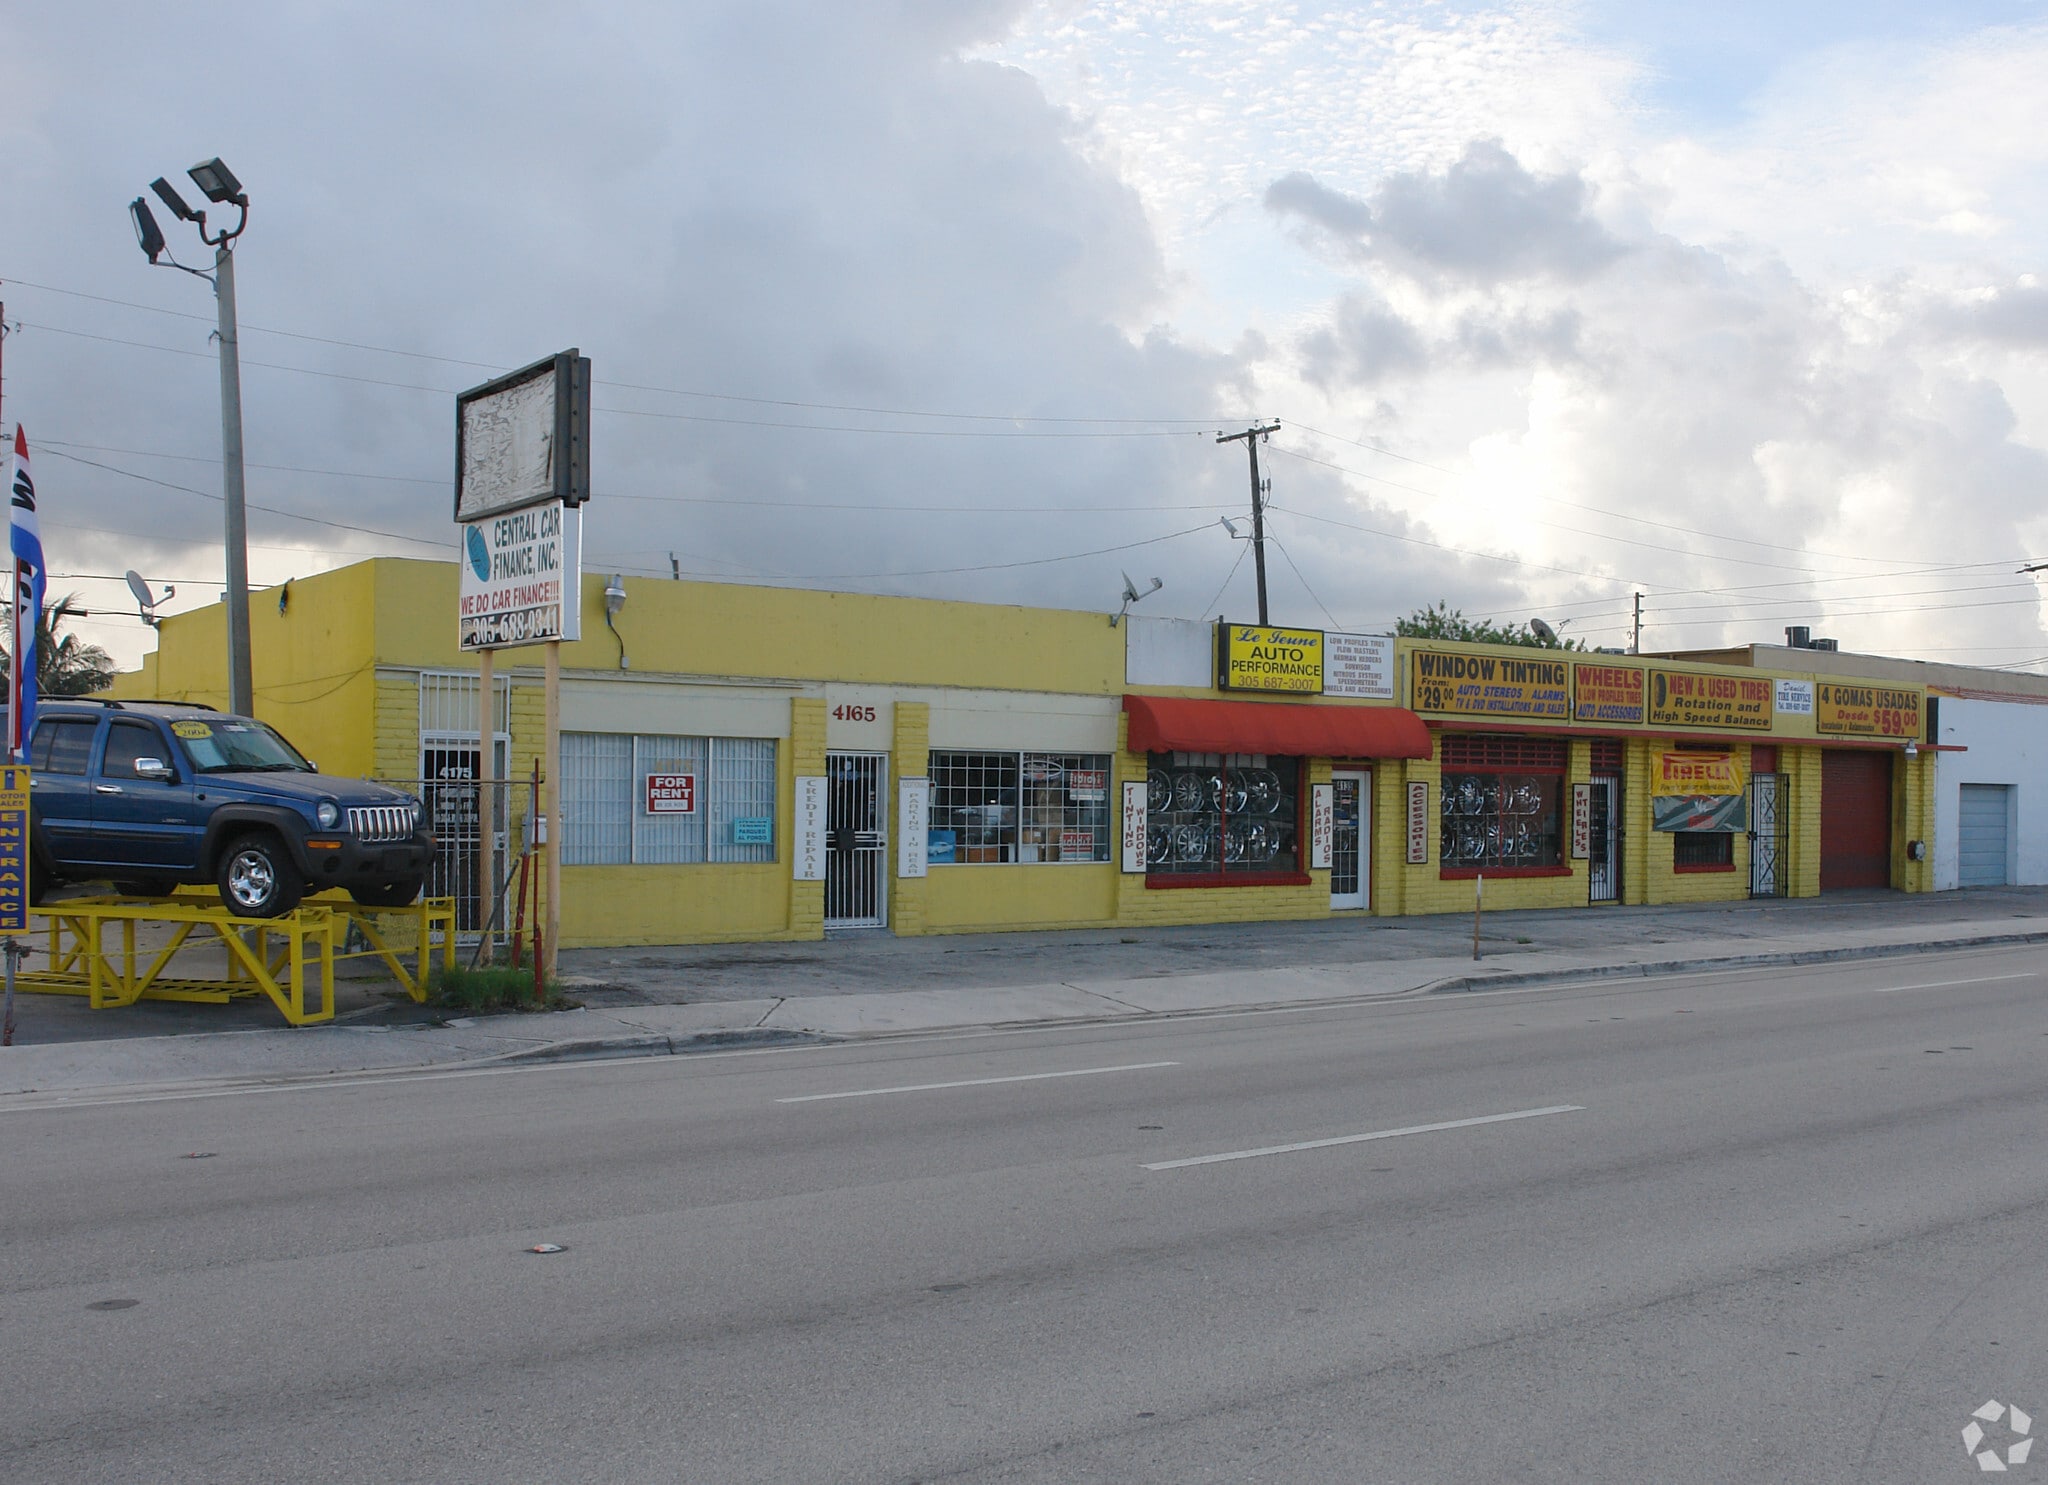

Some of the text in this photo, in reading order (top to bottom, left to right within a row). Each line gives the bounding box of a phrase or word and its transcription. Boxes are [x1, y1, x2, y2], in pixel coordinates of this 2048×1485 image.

[495, 507, 559, 548] CENTRAL CAR
[493, 541, 559, 581] FINANCE, INC.
[460, 580, 560, 616] WE DO CAR FINANCE!!!
[1236, 627, 1261, 643] Le
[1329, 637, 1343, 646] LOW
[1370, 640, 1386, 648] TIRES
[1250, 647, 1303, 661] AUTO
[1231, 659, 1321, 677] PERFORMANCE
[1419, 654, 1565, 686] WINDOW TINTING
[1238, 675, 1315, 690] 305 687-3007
[1337, 678, 1379, 687] SPEEDOMETERS
[1421, 677, 1450, 688] From:
[1577, 666, 1643, 689] WHEELS
[1357, 686, 1392, 695] ACCESSORIES
[1457, 684, 1481, 696] AUTO
[1483, 686, 1523, 699] STEREOS
[1531, 689, 1566, 702] ALARMS
[1583, 688, 1596, 702] LOW
[1597, 690, 1625, 704] PROFILES
[1626, 691, 1642, 705] TIRES
[1669, 675, 1770, 702] NEW & USED TIRES
[1778, 692, 1811, 703] TIRE SERVICE
[1455, 697, 1464, 709] TV
[1487, 699, 1531, 713] INSTALLATIONS
[1546, 704, 1566, 714] SALES
[1674, 697, 1761, 713] Rotation and
[1821, 687, 1918, 711] 4 GOMAS USADAS
[832, 704, 877, 722] 4165
[1577, 703, 1643, 721] AUTO ACCESSORIES
[1653, 711, 1769, 727] High Speed Balance
[1837, 709, 1869, 721] Desde
[439, 767, 472, 778] 4175
[1663, 753, 1730, 780] PIRELLI
[655, 777, 686, 788] FOR
[651, 788, 692, 799] RENT
[1125, 787, 1134, 847] TINTING
[1412, 786, 1424, 861] ACCESSORIES
[1575, 791, 1583, 846] WHEELS
[804, 780, 817, 878] CREDIT REPAIR
[908, 793, 919, 874] PARKING IN REAR
[1136, 807, 1144, 866] WINDOWS
[0, 812, 19, 926] ENTRANCE
